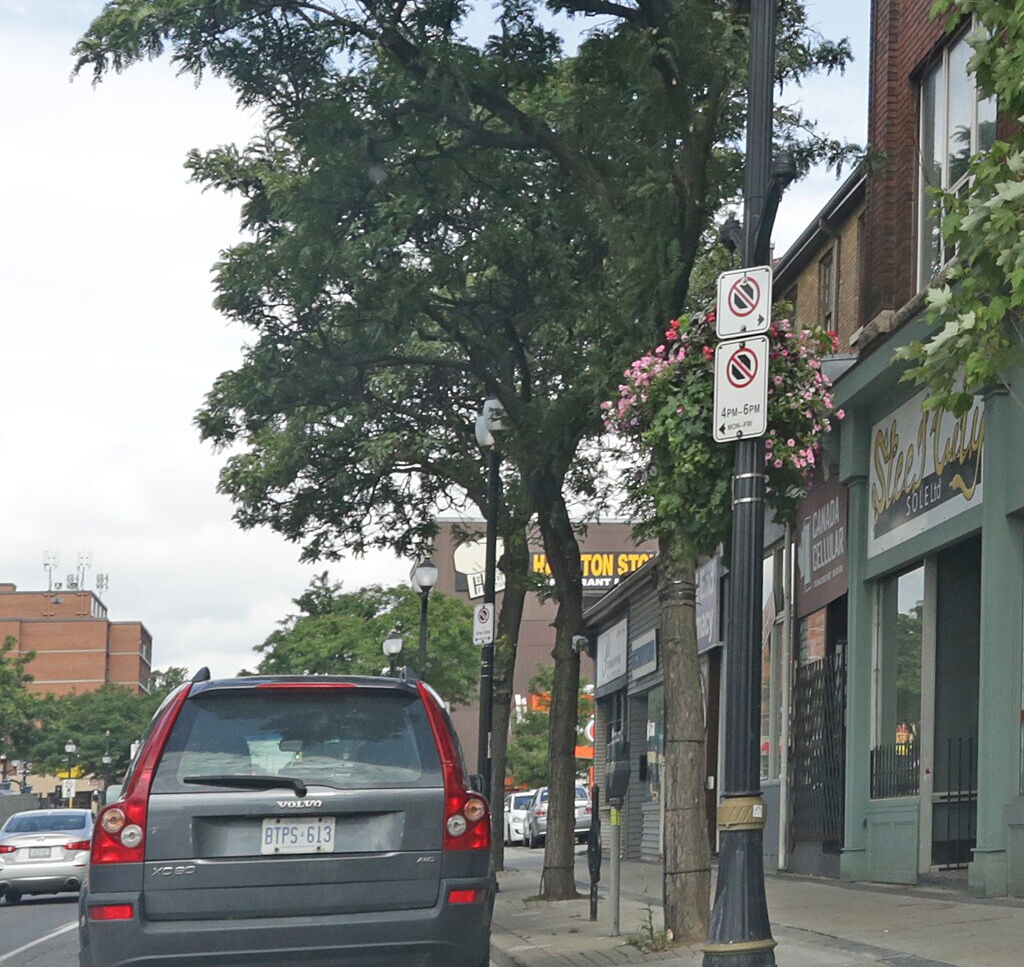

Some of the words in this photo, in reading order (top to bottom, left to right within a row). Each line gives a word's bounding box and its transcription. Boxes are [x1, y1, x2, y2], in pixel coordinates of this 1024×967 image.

[813, 496, 840, 539] CANADA
[905, 486, 929, 516] SOLE
[813, 527, 844, 571] CELLULAR
[276, 799, 323, 808] VOLVO
